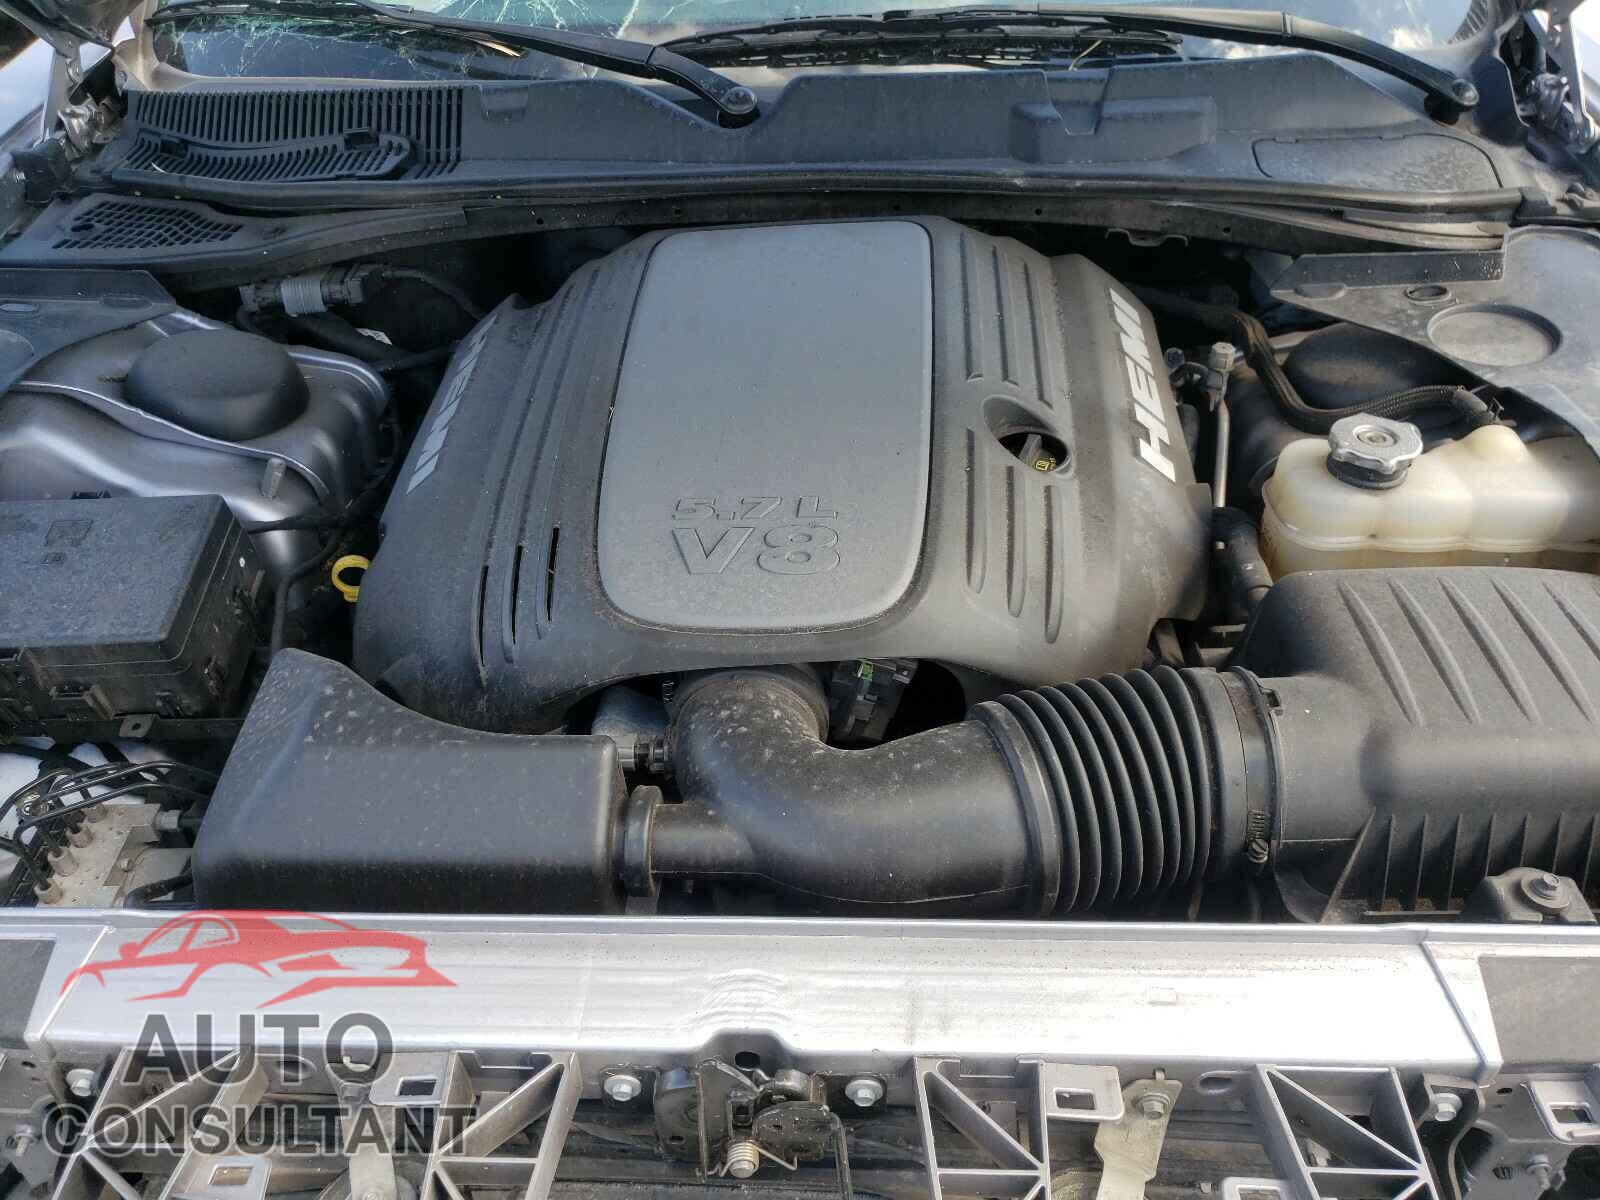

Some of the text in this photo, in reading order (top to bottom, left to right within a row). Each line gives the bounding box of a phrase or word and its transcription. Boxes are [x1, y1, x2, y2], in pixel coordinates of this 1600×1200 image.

[1109, 287, 1177, 483] HEMI
[671, 496, 839, 521] 5.7L
[671, 524, 841, 576] V8
